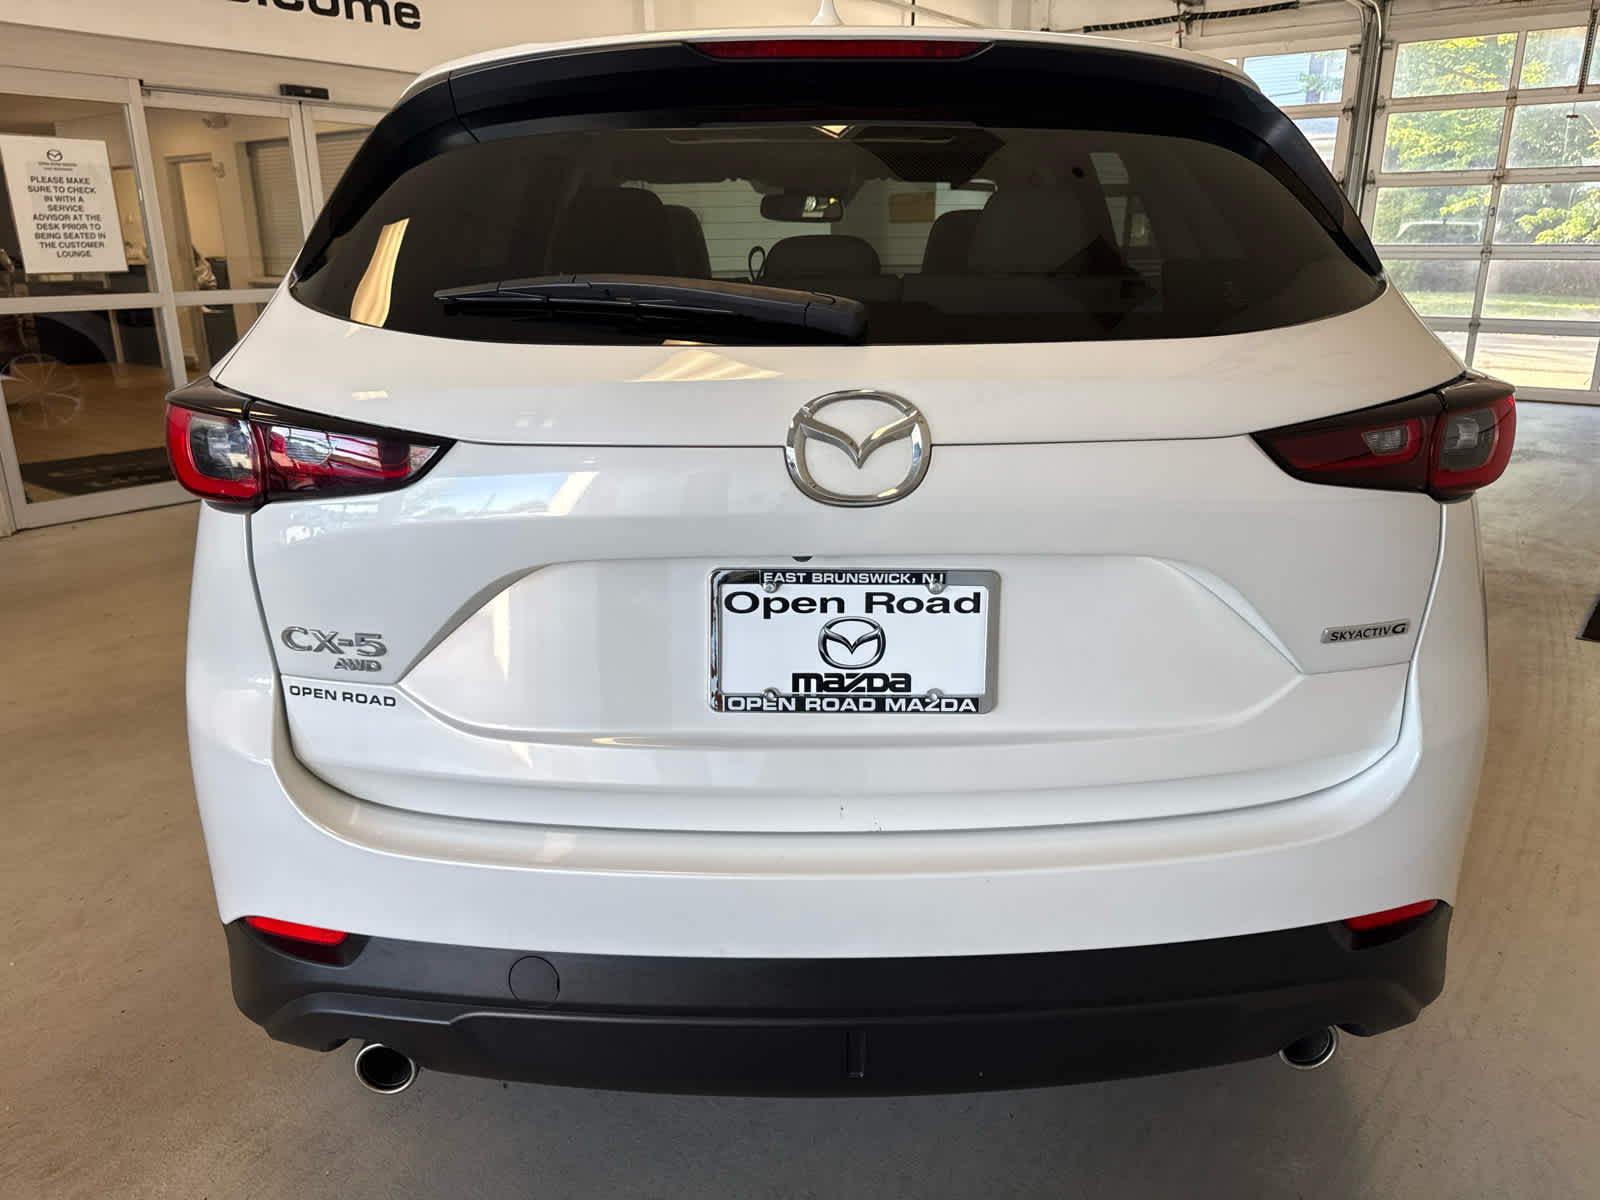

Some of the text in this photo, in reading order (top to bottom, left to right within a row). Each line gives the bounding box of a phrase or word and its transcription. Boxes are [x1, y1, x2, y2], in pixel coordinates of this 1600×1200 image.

[30, 176, 91, 185] PLEASE MAKE
[27, 185, 51, 193] SURE
[66, 186, 96, 194] CHECK
[34, 232, 61, 240] BEING
[58, 241, 105, 249] CUSTOMER
[763, 572, 807, 584] EAST
[811, 572, 916, 584] BRUNSWICK,
[724, 591, 981, 619] Open Road
[281, 626, 388, 658] CX-5
[334, 658, 383, 673] AWD
[289, 685, 397, 707] OPEN ROAD
[727, 697, 978, 712] OPEN ROAD MAZDA
